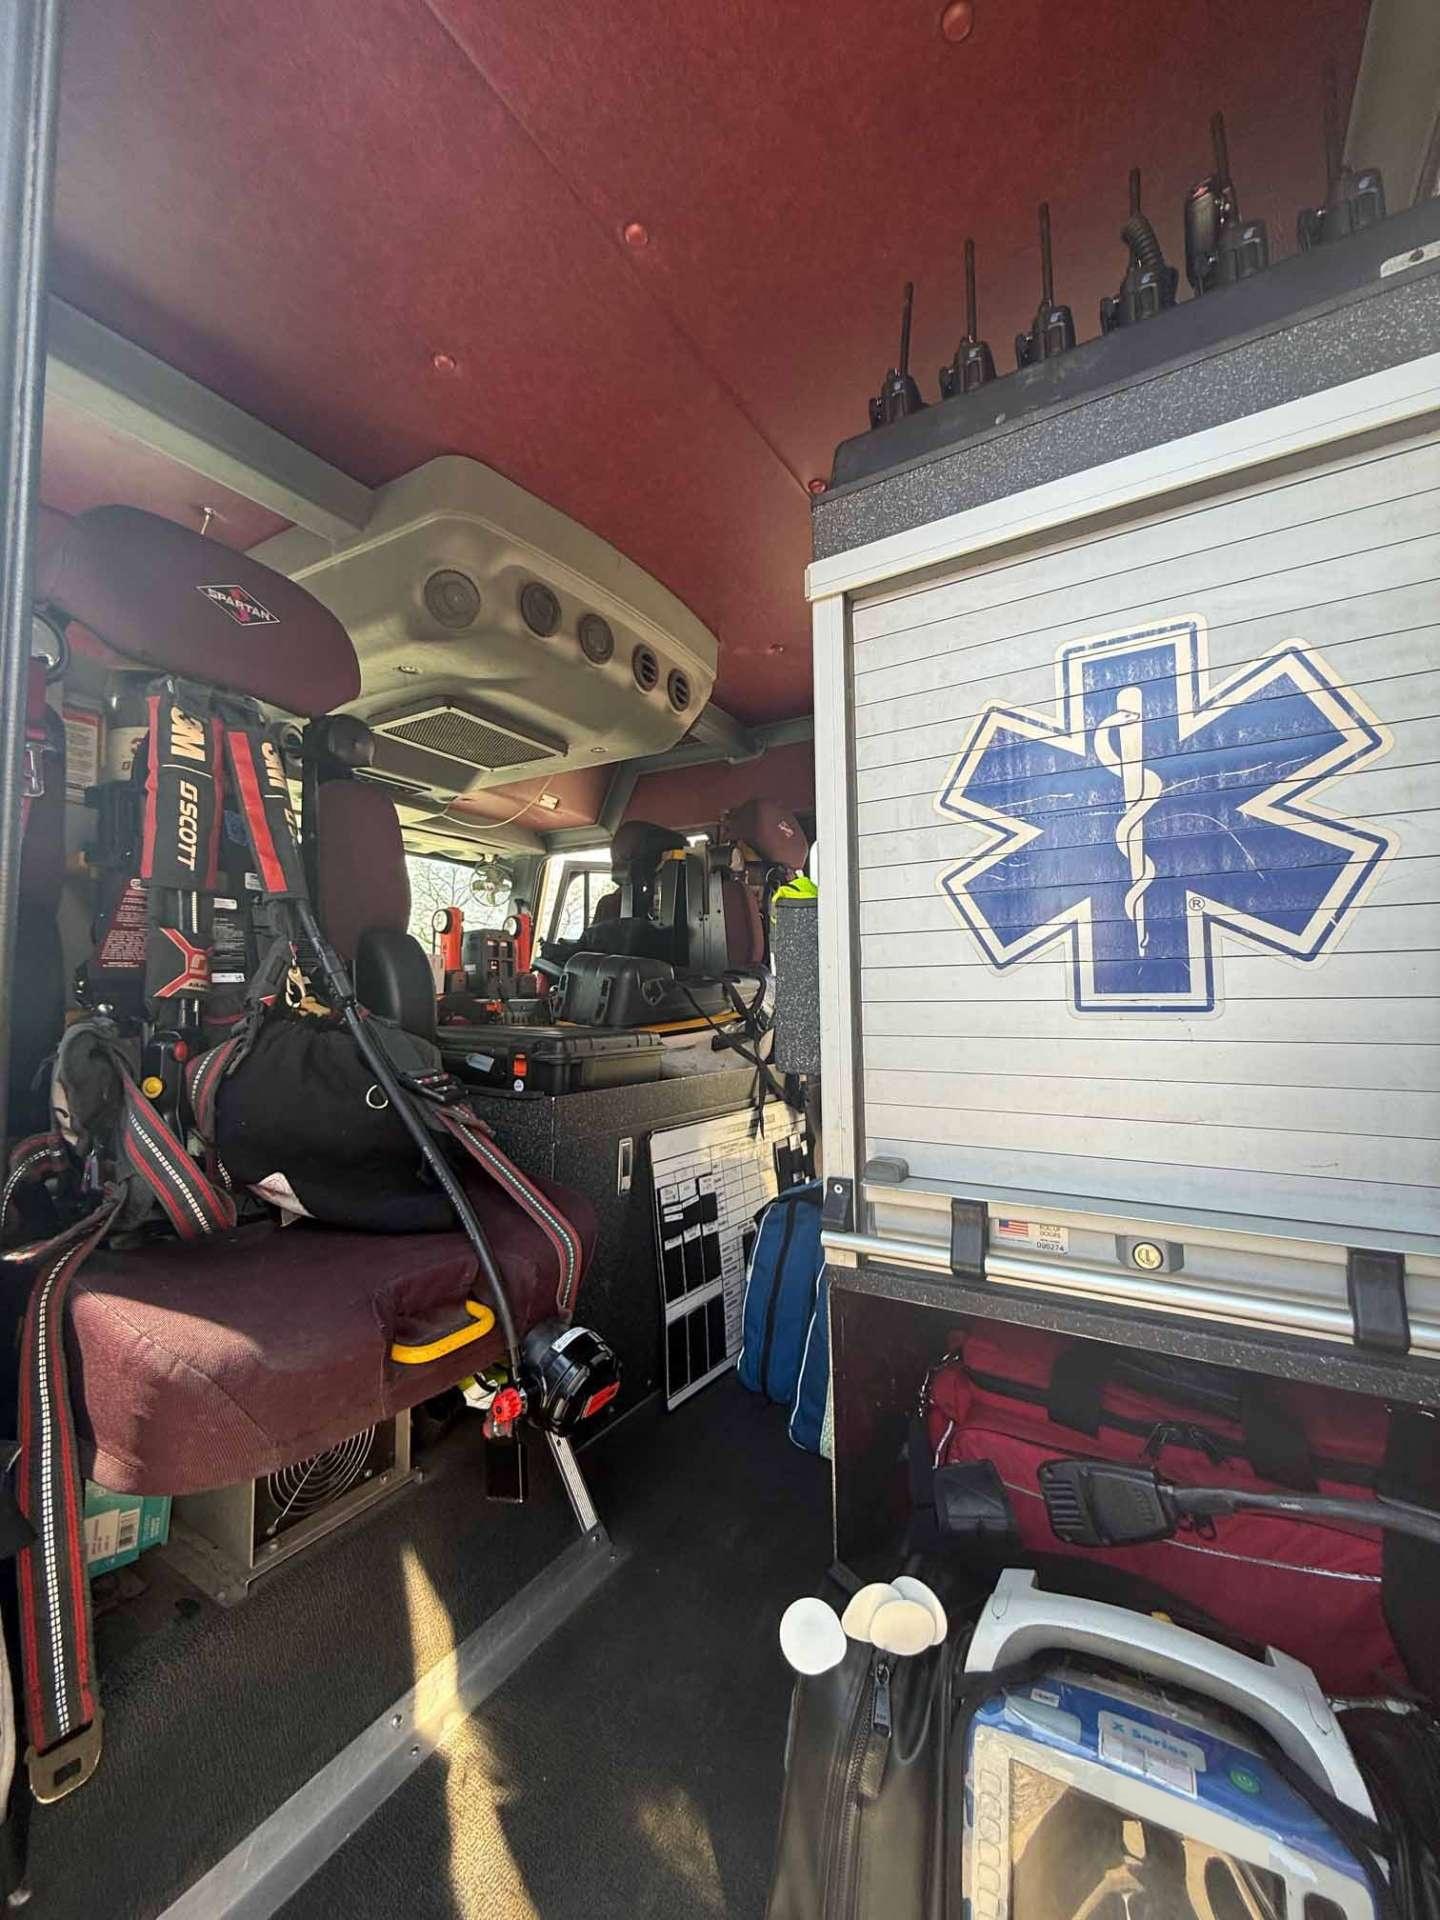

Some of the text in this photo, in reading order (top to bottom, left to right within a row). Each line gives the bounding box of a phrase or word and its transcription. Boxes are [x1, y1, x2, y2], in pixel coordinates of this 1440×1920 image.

[207, 587, 270, 621] SPARTAN
[170, 706, 206, 762] 3M
[261, 742, 287, 790] 3M
[178, 796, 199, 871] SCOTT
[1111, 1720, 1125, 1734] X
